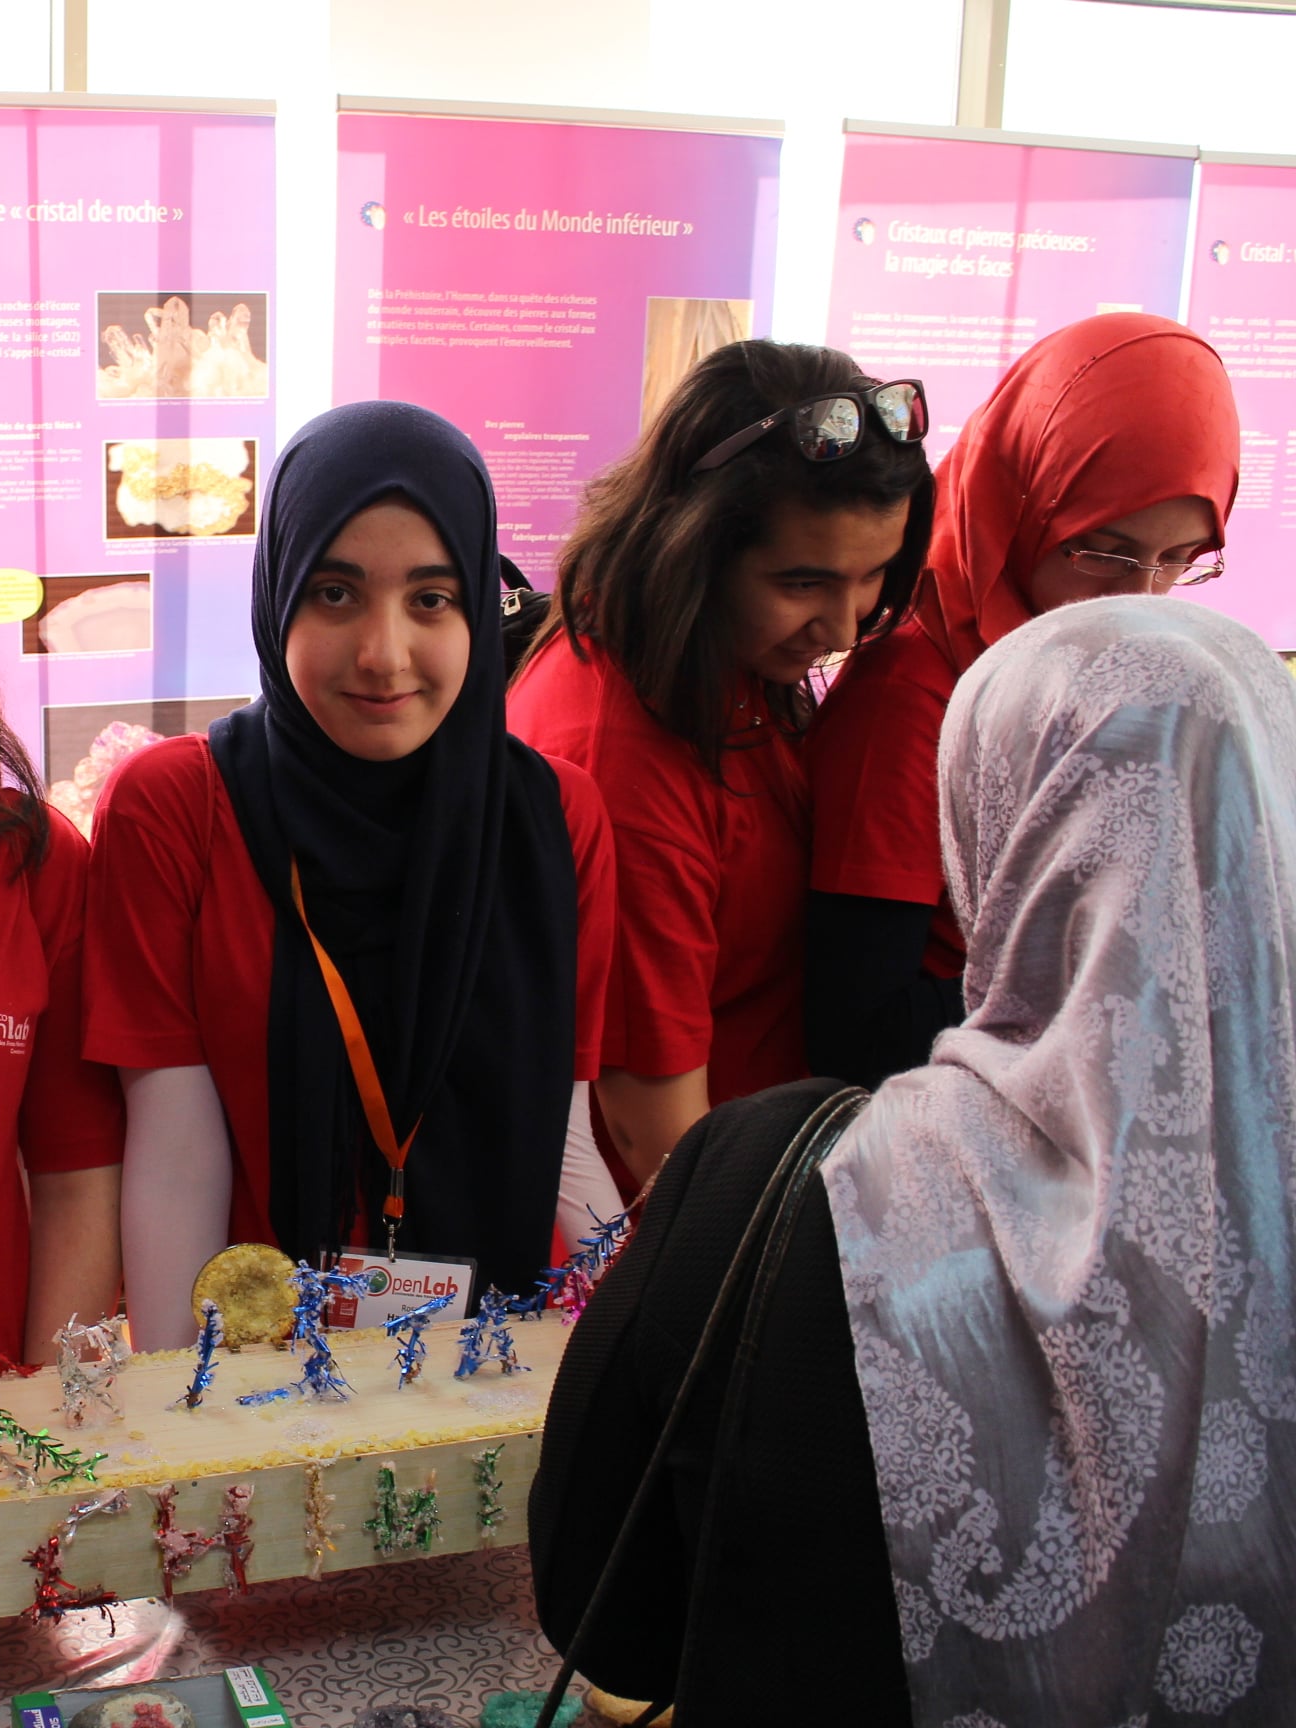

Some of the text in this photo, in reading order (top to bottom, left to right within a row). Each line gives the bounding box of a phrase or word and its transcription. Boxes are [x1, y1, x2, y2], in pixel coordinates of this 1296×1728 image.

[25, 200, 83, 222] cristal
[89, 200, 111, 223] de
[117, 200, 166, 223] roche
[419, 204, 678, 235] Les étoiles du Monde inférieur
[888, 220, 1088, 254] Cristaux et pierres précieuses
[885, 250, 1014, 279] la magie des faces
[1239, 240, 1287, 264] Cristal
